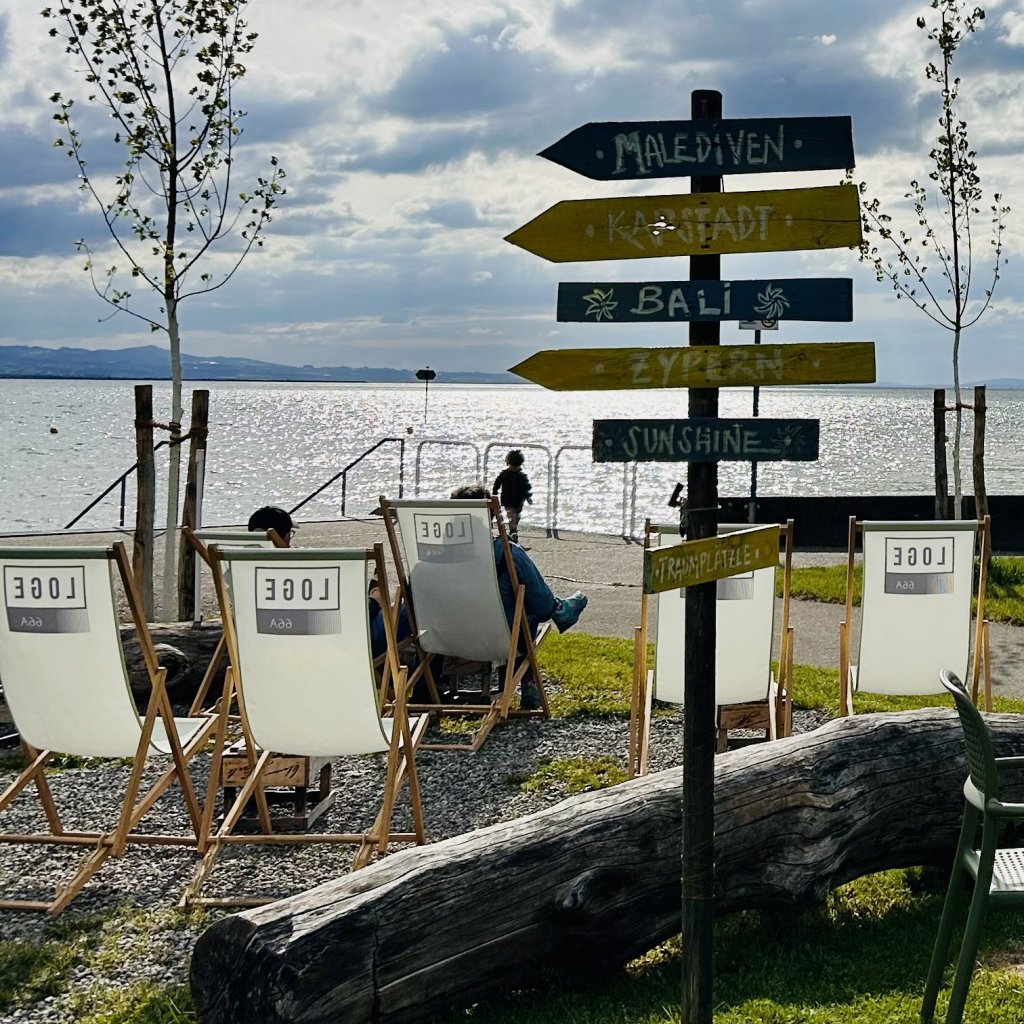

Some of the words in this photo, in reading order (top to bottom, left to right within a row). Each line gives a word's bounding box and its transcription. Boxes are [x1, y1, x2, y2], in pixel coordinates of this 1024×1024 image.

[630, 283, 731, 317] BALI
[630, 348, 784, 385] ZYPERN
[623, 424, 781, 457] SUNSHINE
